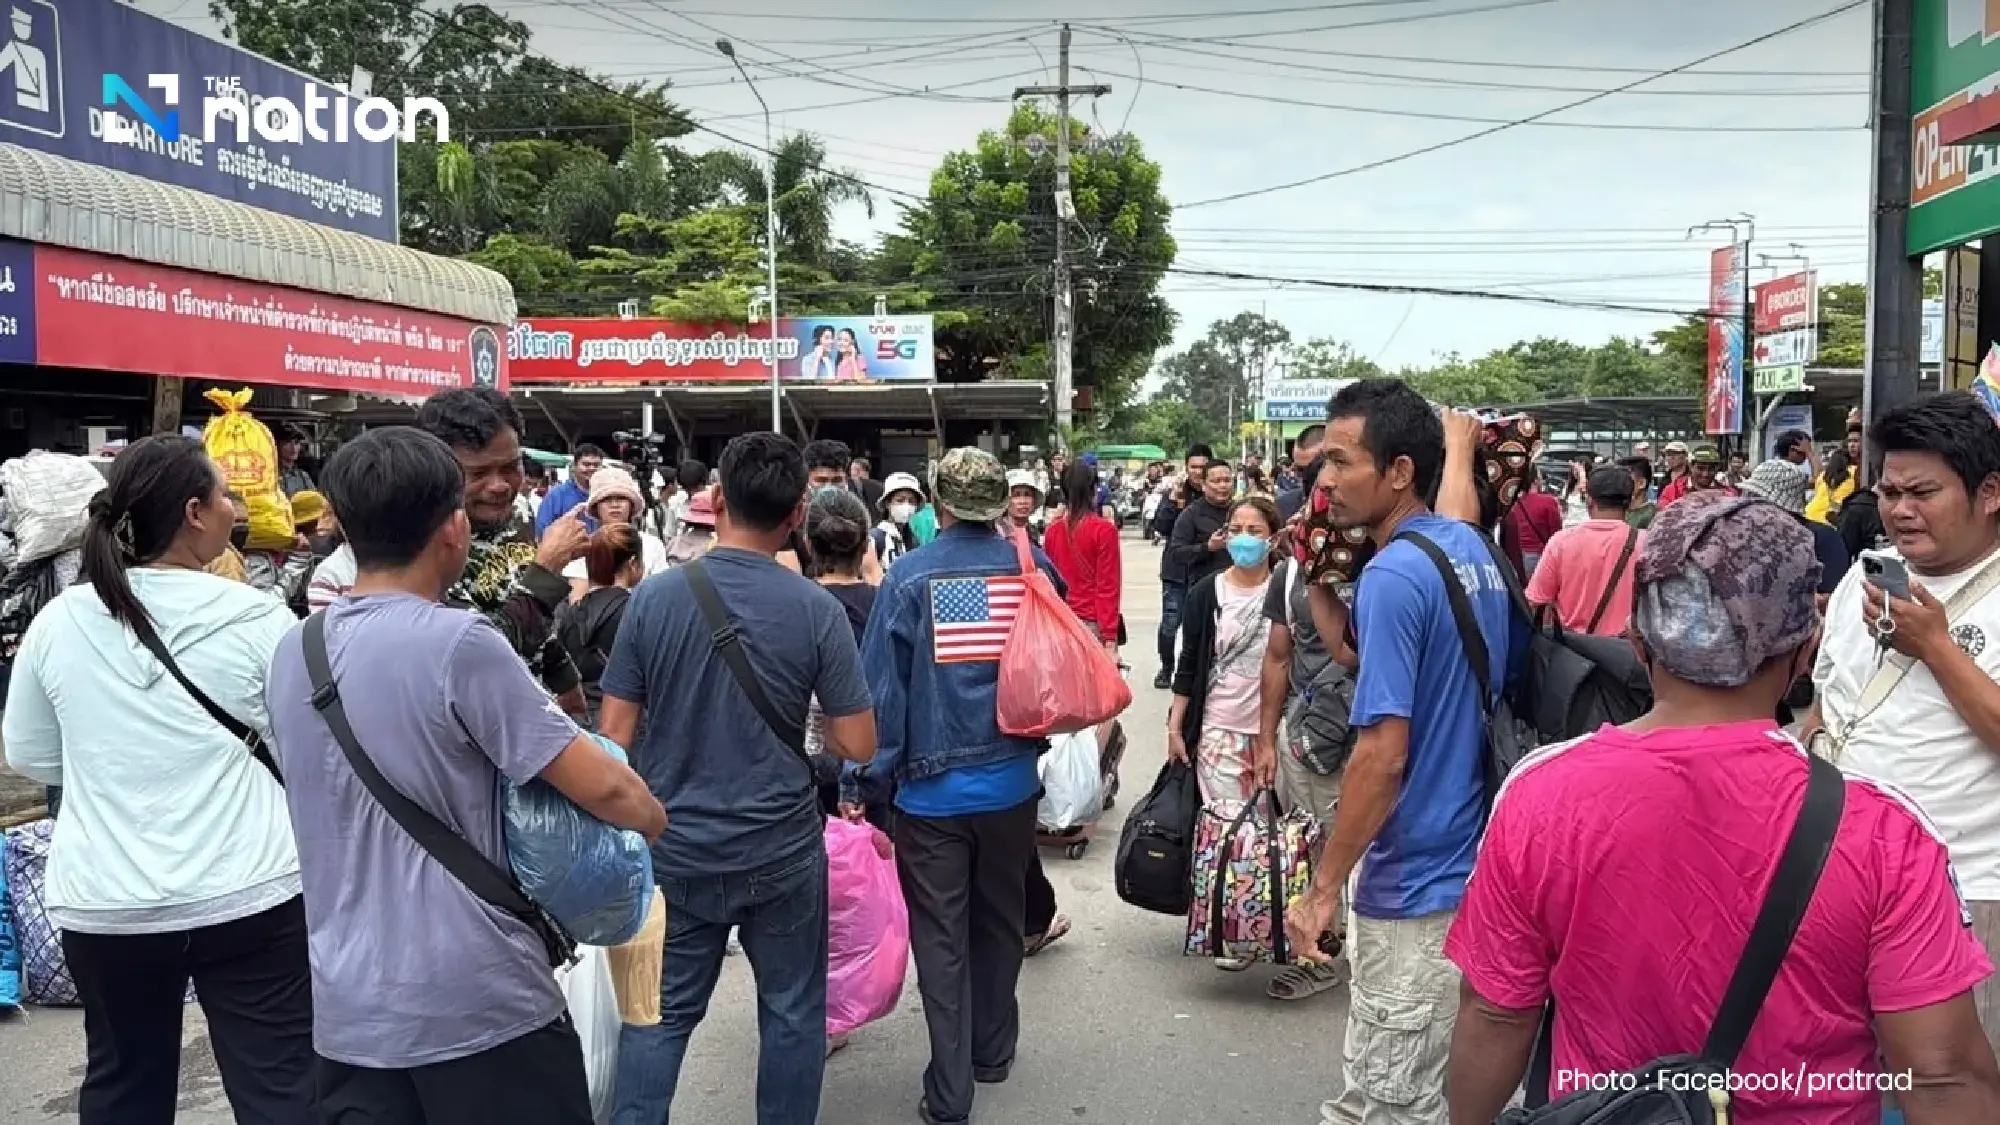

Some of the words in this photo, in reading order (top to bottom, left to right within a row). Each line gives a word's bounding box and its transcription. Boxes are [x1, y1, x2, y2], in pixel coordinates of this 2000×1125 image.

[868, 324, 896, 334] true
[876, 339, 918, 360] 5G
[1756, 371, 1777, 390] TAXI
